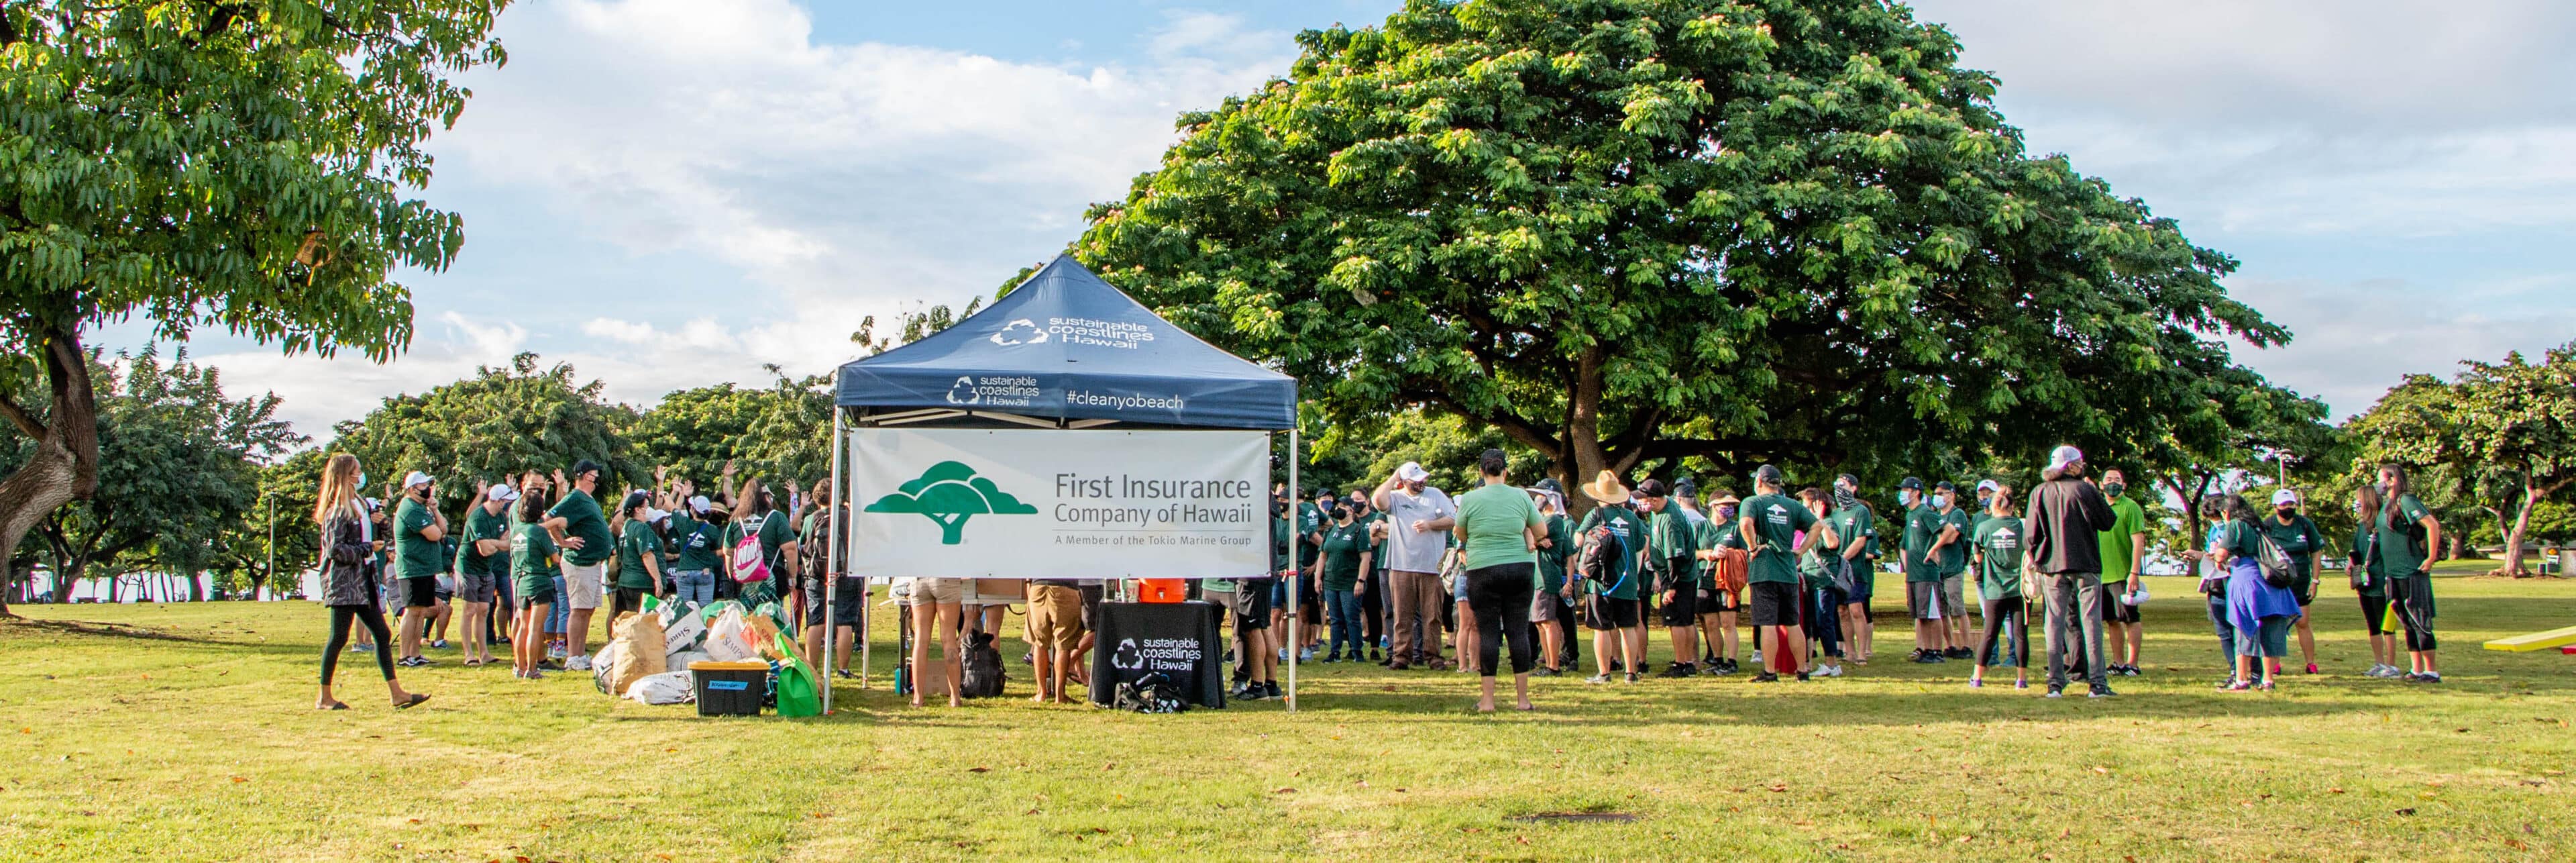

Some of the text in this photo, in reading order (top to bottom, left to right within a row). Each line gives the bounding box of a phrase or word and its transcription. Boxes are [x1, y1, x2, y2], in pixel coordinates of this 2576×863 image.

[1049, 317, 1148, 332] sustainable
[1049, 324, 1155, 342] coastlines
[1062, 334, 1138, 350] Hawaii
[980, 376, 1036, 387] sustainable
[979, 385, 1040, 397] coastlines
[986, 396, 1029, 407] Hawaii
[1067, 390, 1183, 410] #cleanyobeach
[1057, 473, 1251, 499] First Insurance
[1055, 503, 1251, 527] Company of Hawaii
[1055, 536, 1251, 546] A Member of the Tokio Marine Group
[1143, 638, 1199, 648] sustainable
[1143, 646, 1201, 660] coastlines
[1150, 658, 1192, 671] Hawaii
